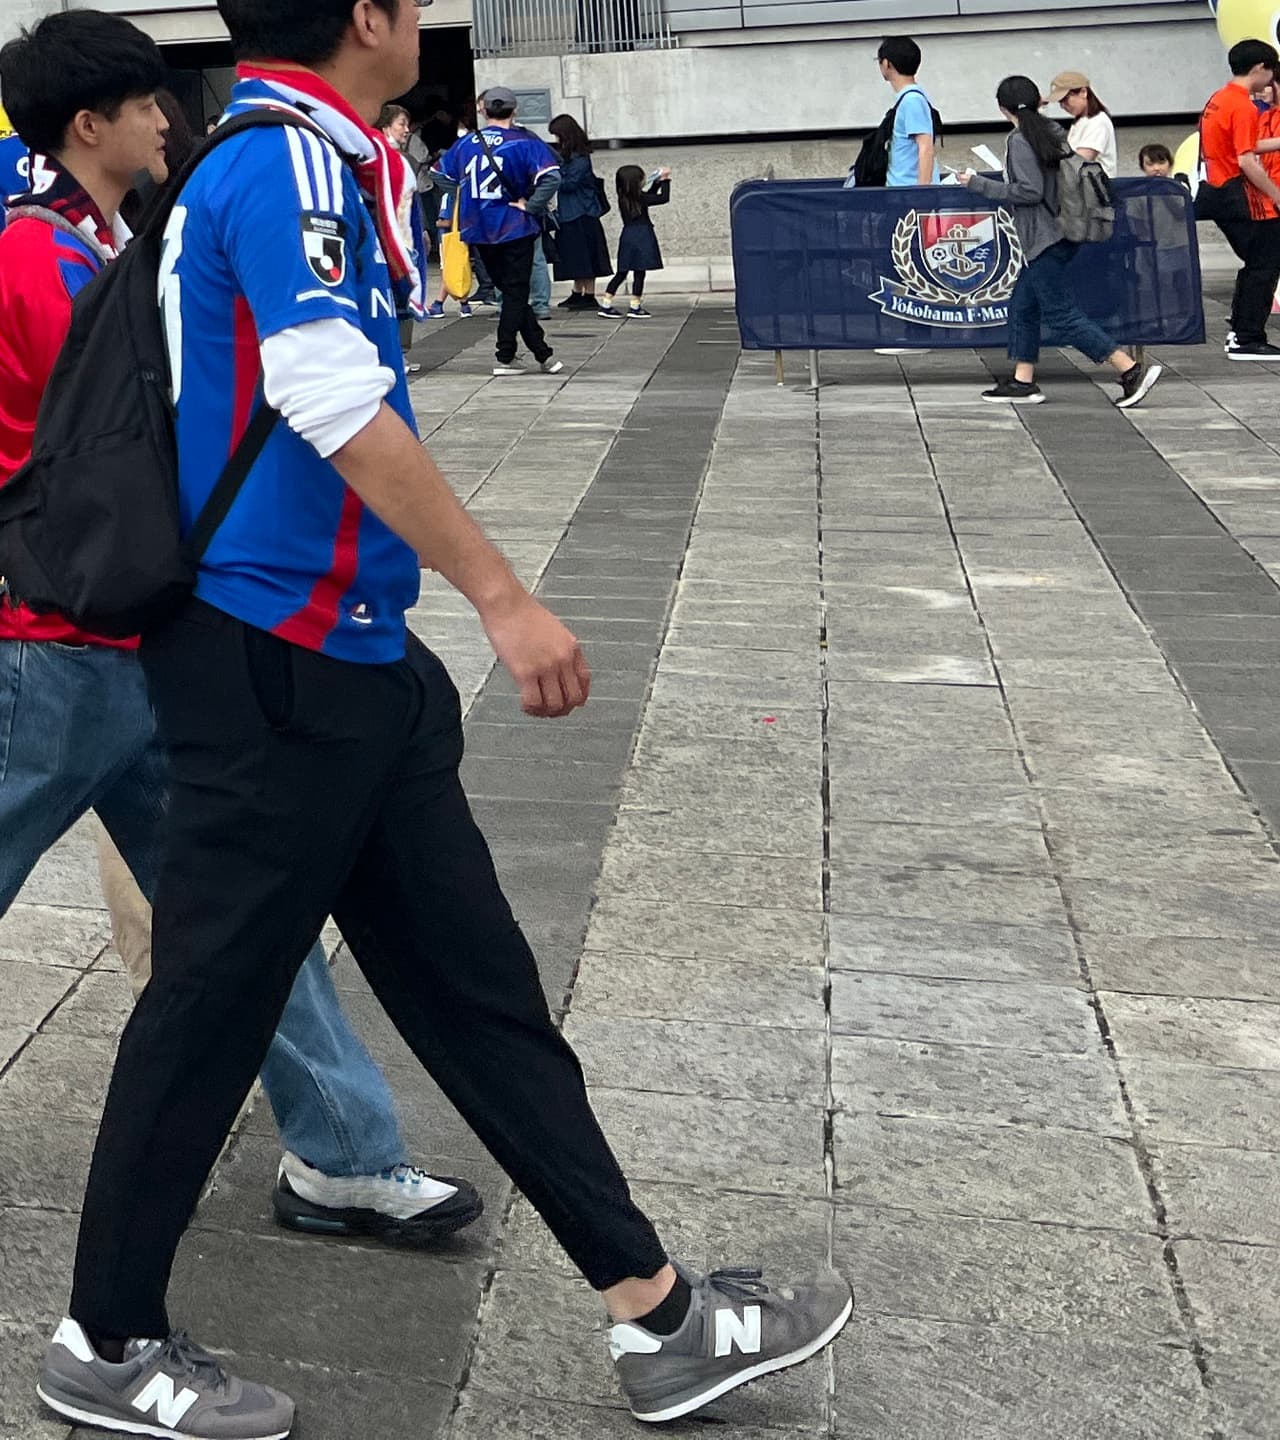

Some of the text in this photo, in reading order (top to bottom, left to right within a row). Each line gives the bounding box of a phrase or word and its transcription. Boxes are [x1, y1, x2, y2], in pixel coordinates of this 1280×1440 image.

[891, 295, 964, 322] Yokohama
[714, 1305, 761, 1358] N
[131, 1371, 199, 1429] N
